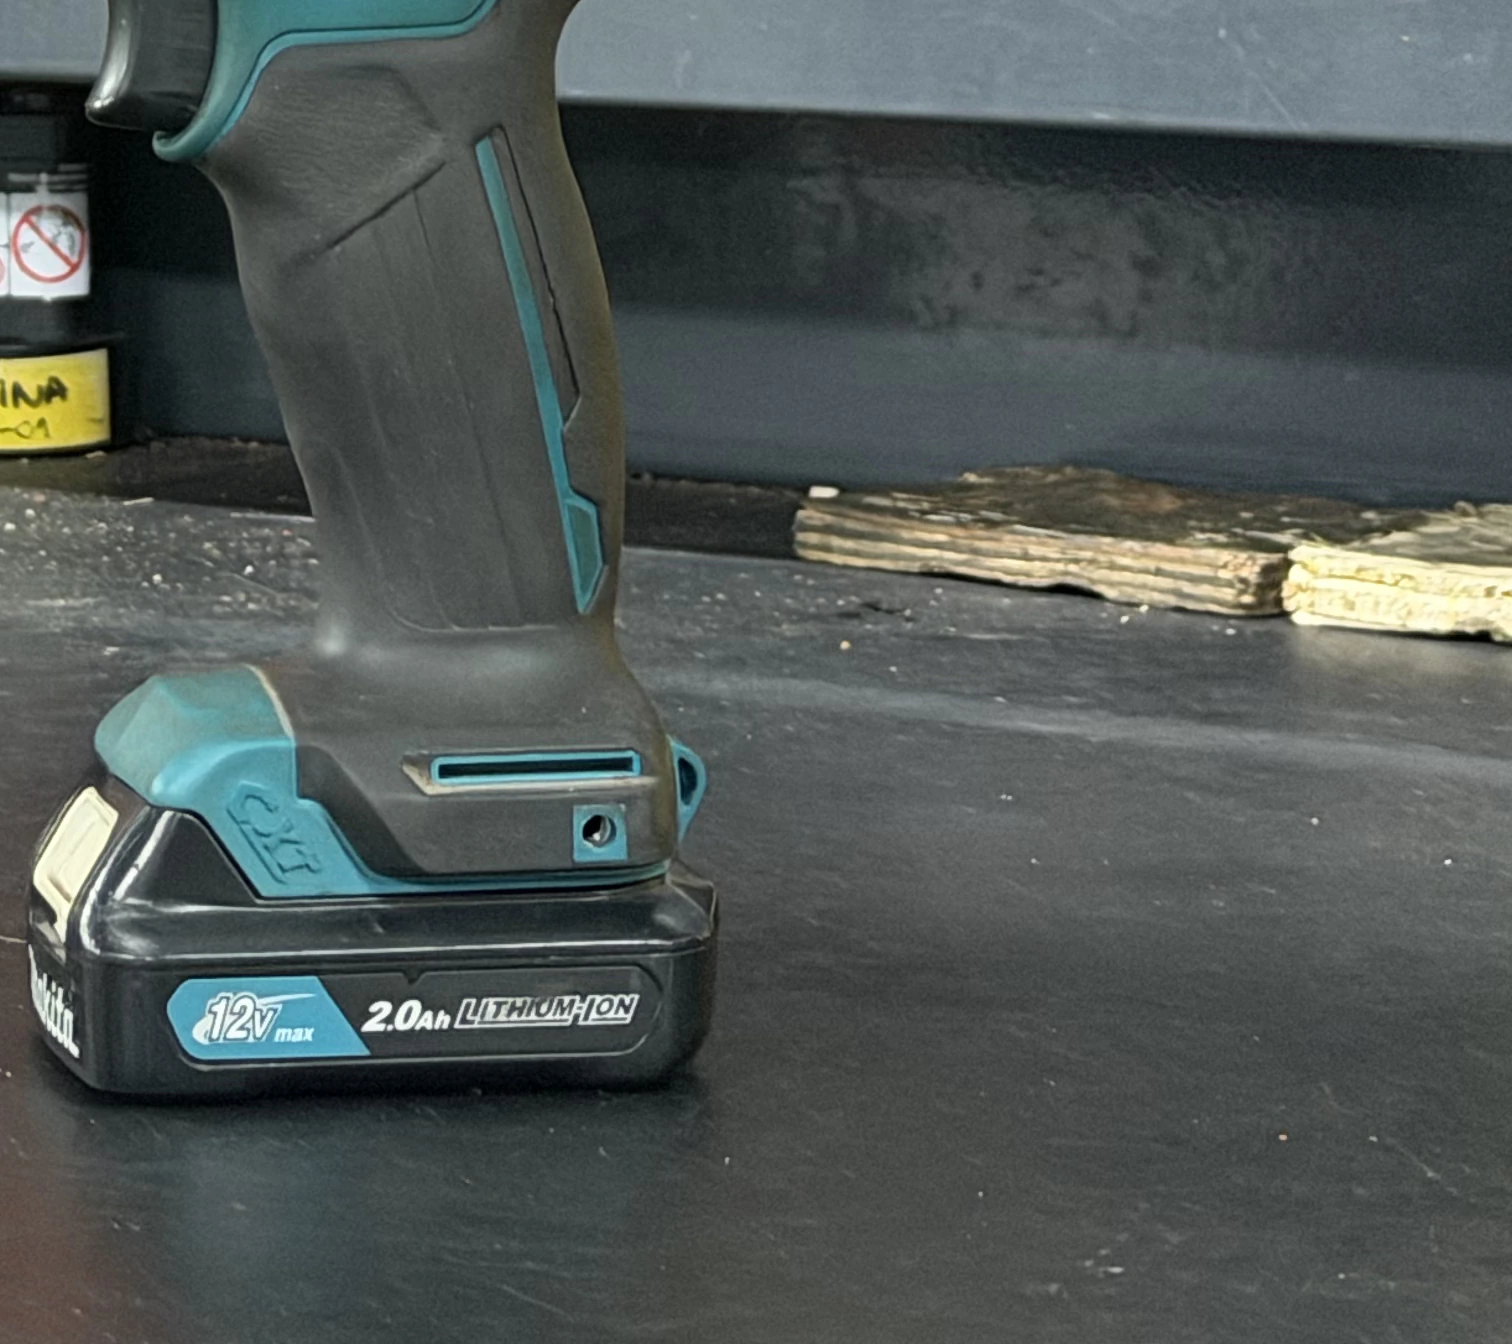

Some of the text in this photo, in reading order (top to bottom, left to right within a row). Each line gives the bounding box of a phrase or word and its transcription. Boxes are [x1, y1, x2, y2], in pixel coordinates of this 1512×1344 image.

[360, 994, 640, 1033] 2.0Ah LITHIUM-ION
[273, 1026, 315, 1043] max
